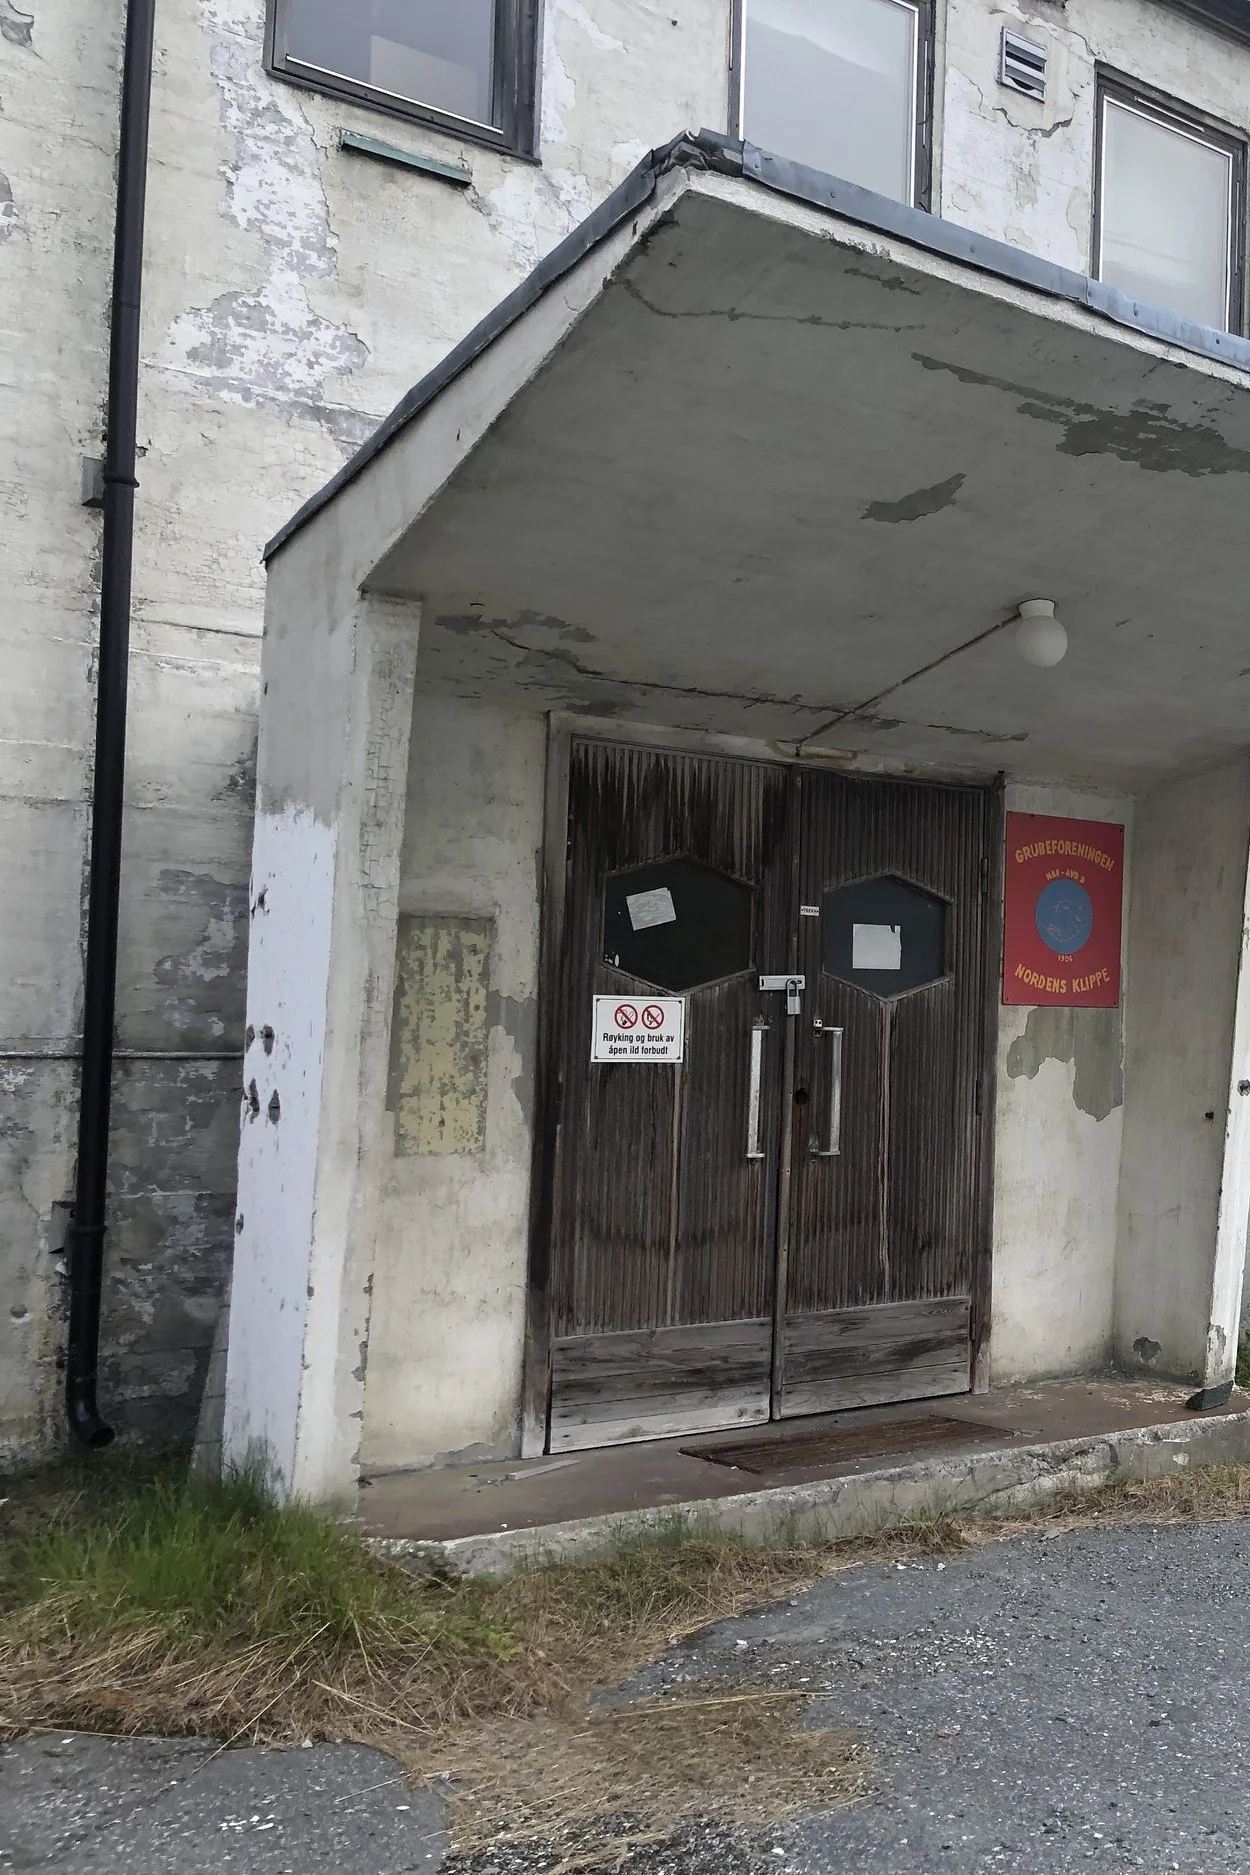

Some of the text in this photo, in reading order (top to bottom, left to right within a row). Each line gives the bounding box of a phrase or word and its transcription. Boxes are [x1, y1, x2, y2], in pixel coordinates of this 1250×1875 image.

[1015, 840, 1115, 871] GRUBEFORENINGEN
[1014, 963, 1110, 993] NORDENS KLIPPE
[602, 1032, 634, 1043] Røyking
[635, 1035, 645, 1043] og
[647, 1033, 664, 1042] bruk
[608, 1045, 668, 1056] åpen ild forbudt
